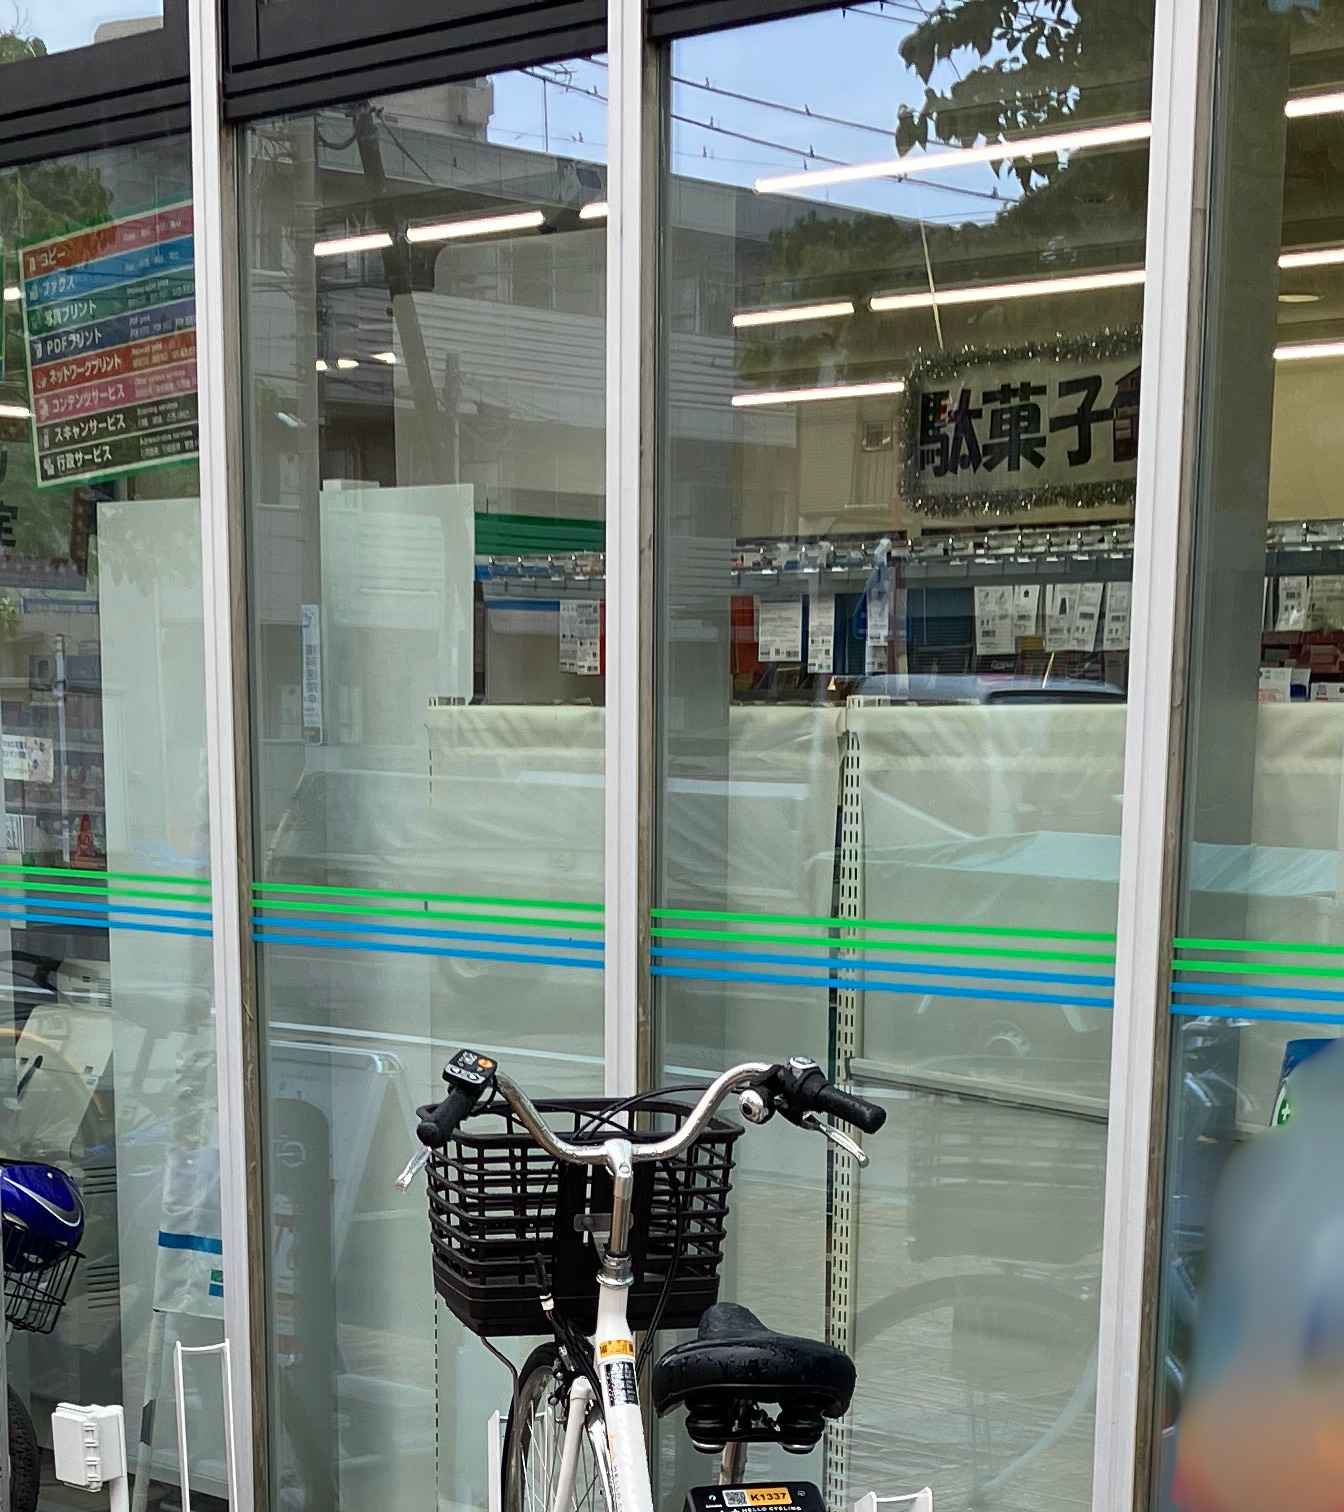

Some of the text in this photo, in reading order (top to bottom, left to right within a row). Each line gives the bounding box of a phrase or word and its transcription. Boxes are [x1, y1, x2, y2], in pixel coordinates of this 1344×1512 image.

[47, 327, 103, 354] PDFプリント
[48, 353, 122, 385] ネットワークプリント
[52, 384, 126, 414] コンテンツサービス
[54, 414, 127, 442] スキャンサービス
[56, 445, 113, 474] 行政サービス
[750, 1492, 787, 1502] K1337
